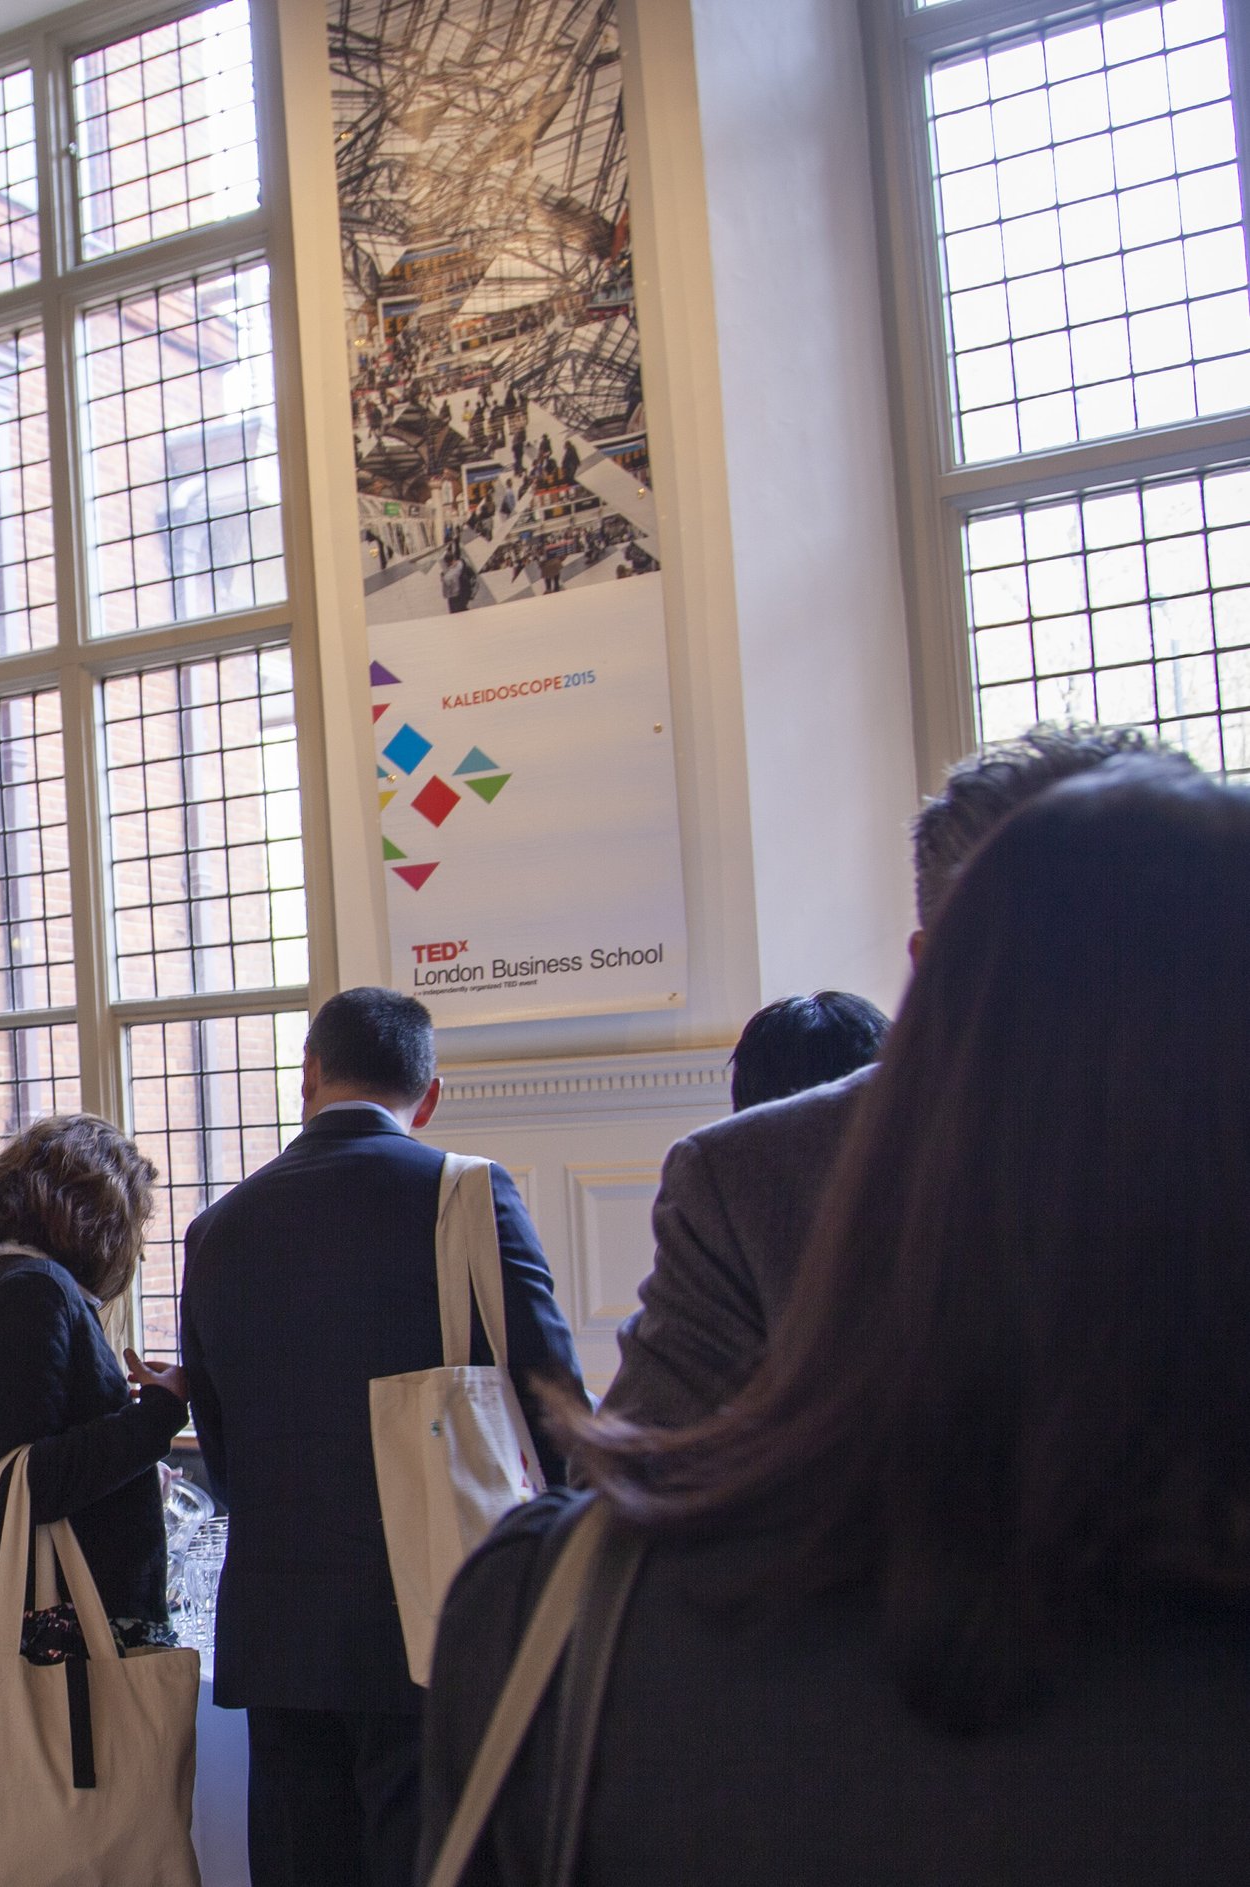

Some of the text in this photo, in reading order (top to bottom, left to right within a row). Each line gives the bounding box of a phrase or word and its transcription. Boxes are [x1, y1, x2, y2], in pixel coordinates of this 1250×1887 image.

[442, 670, 596, 710] KALEIDOSCOPE2015
[412, 940, 469, 964] TEDx
[414, 943, 663, 986] London Business School
